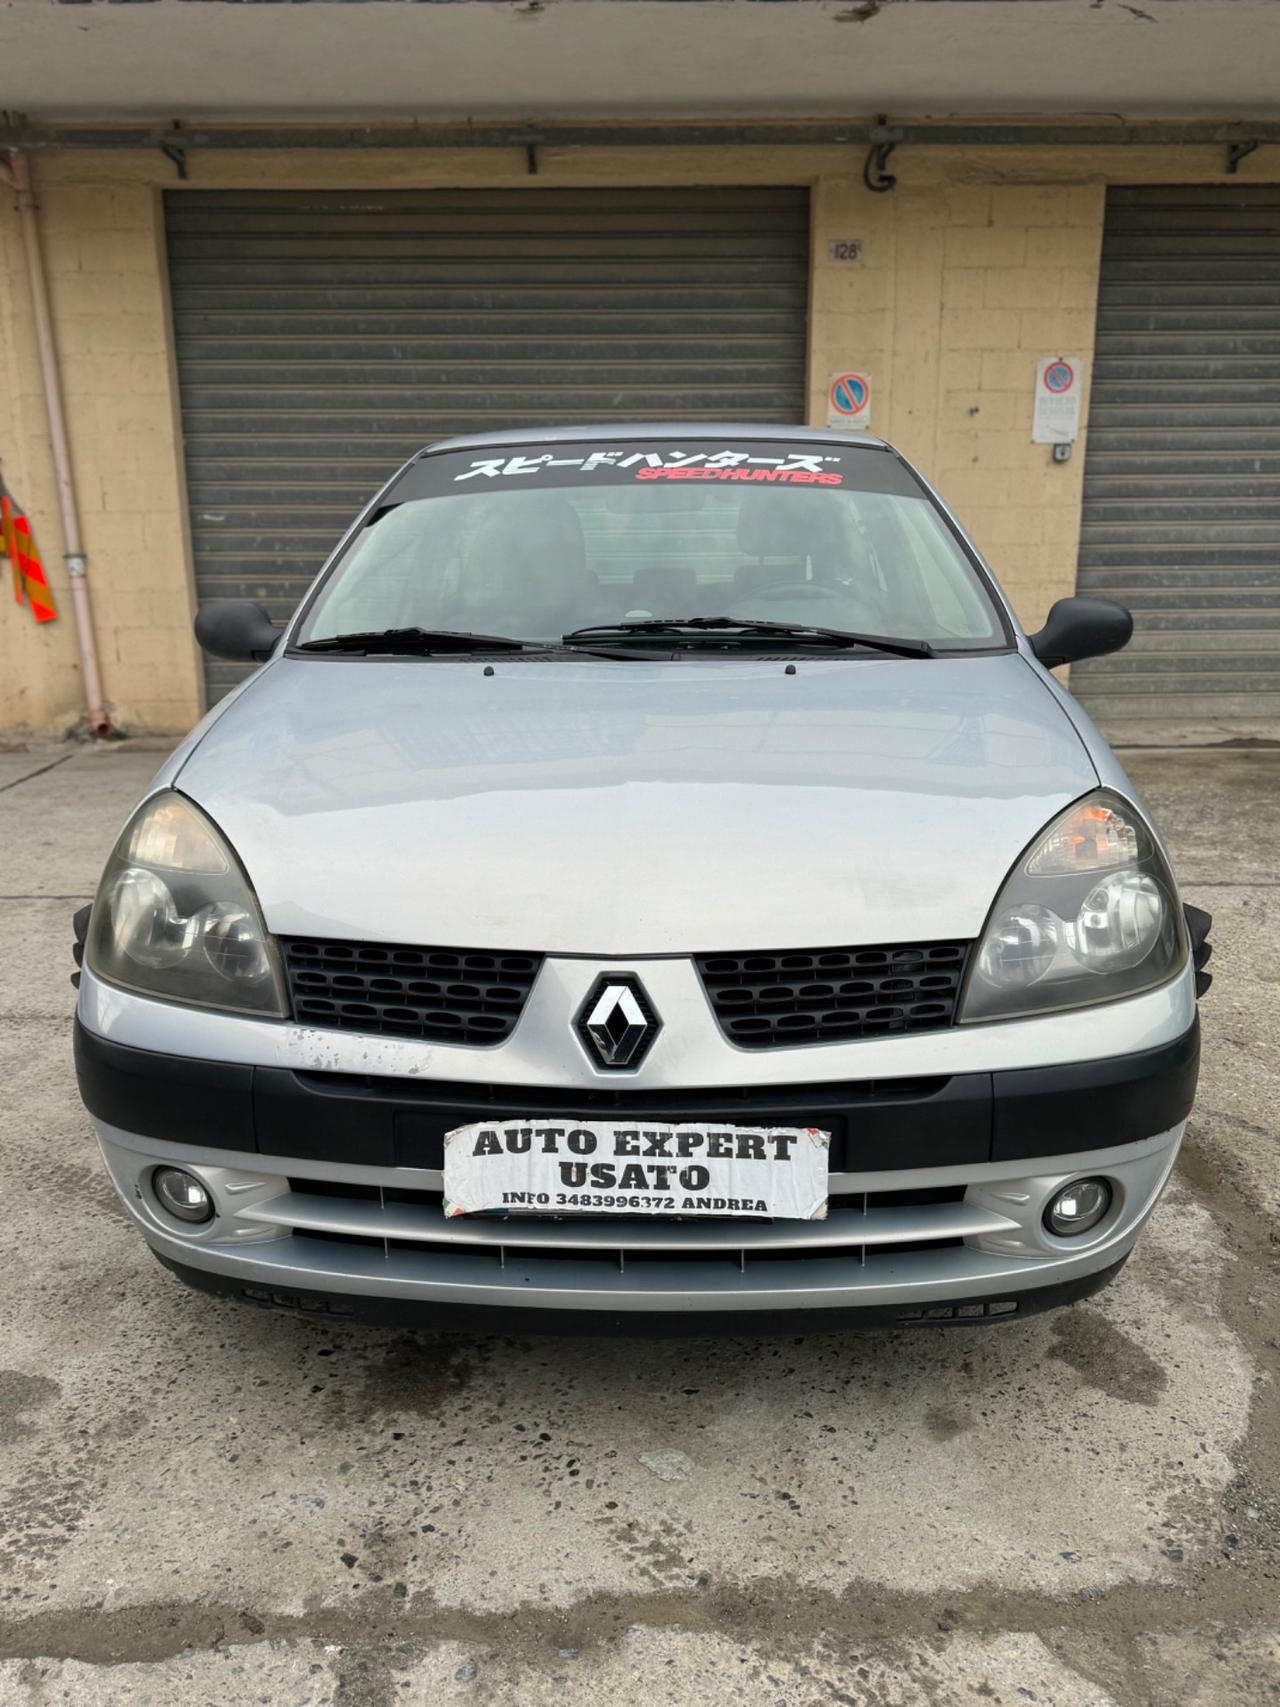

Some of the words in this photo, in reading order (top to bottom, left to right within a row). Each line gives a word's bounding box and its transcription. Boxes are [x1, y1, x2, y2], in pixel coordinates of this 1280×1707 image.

[834, 243, 858, 260] 128
[454, 450, 840, 481] スピードハンターズ
[635, 467, 843, 485] SPEEDHUNTERS
[472, 1128, 598, 1157] AUTO
[613, 1130, 798, 1161] EXPERT
[558, 1161, 711, 1191] USATO
[502, 1192, 550, 1205] INFO
[555, 1193, 676, 1210] 3483996372
[681, 1197, 769, 1212] ANDREA
